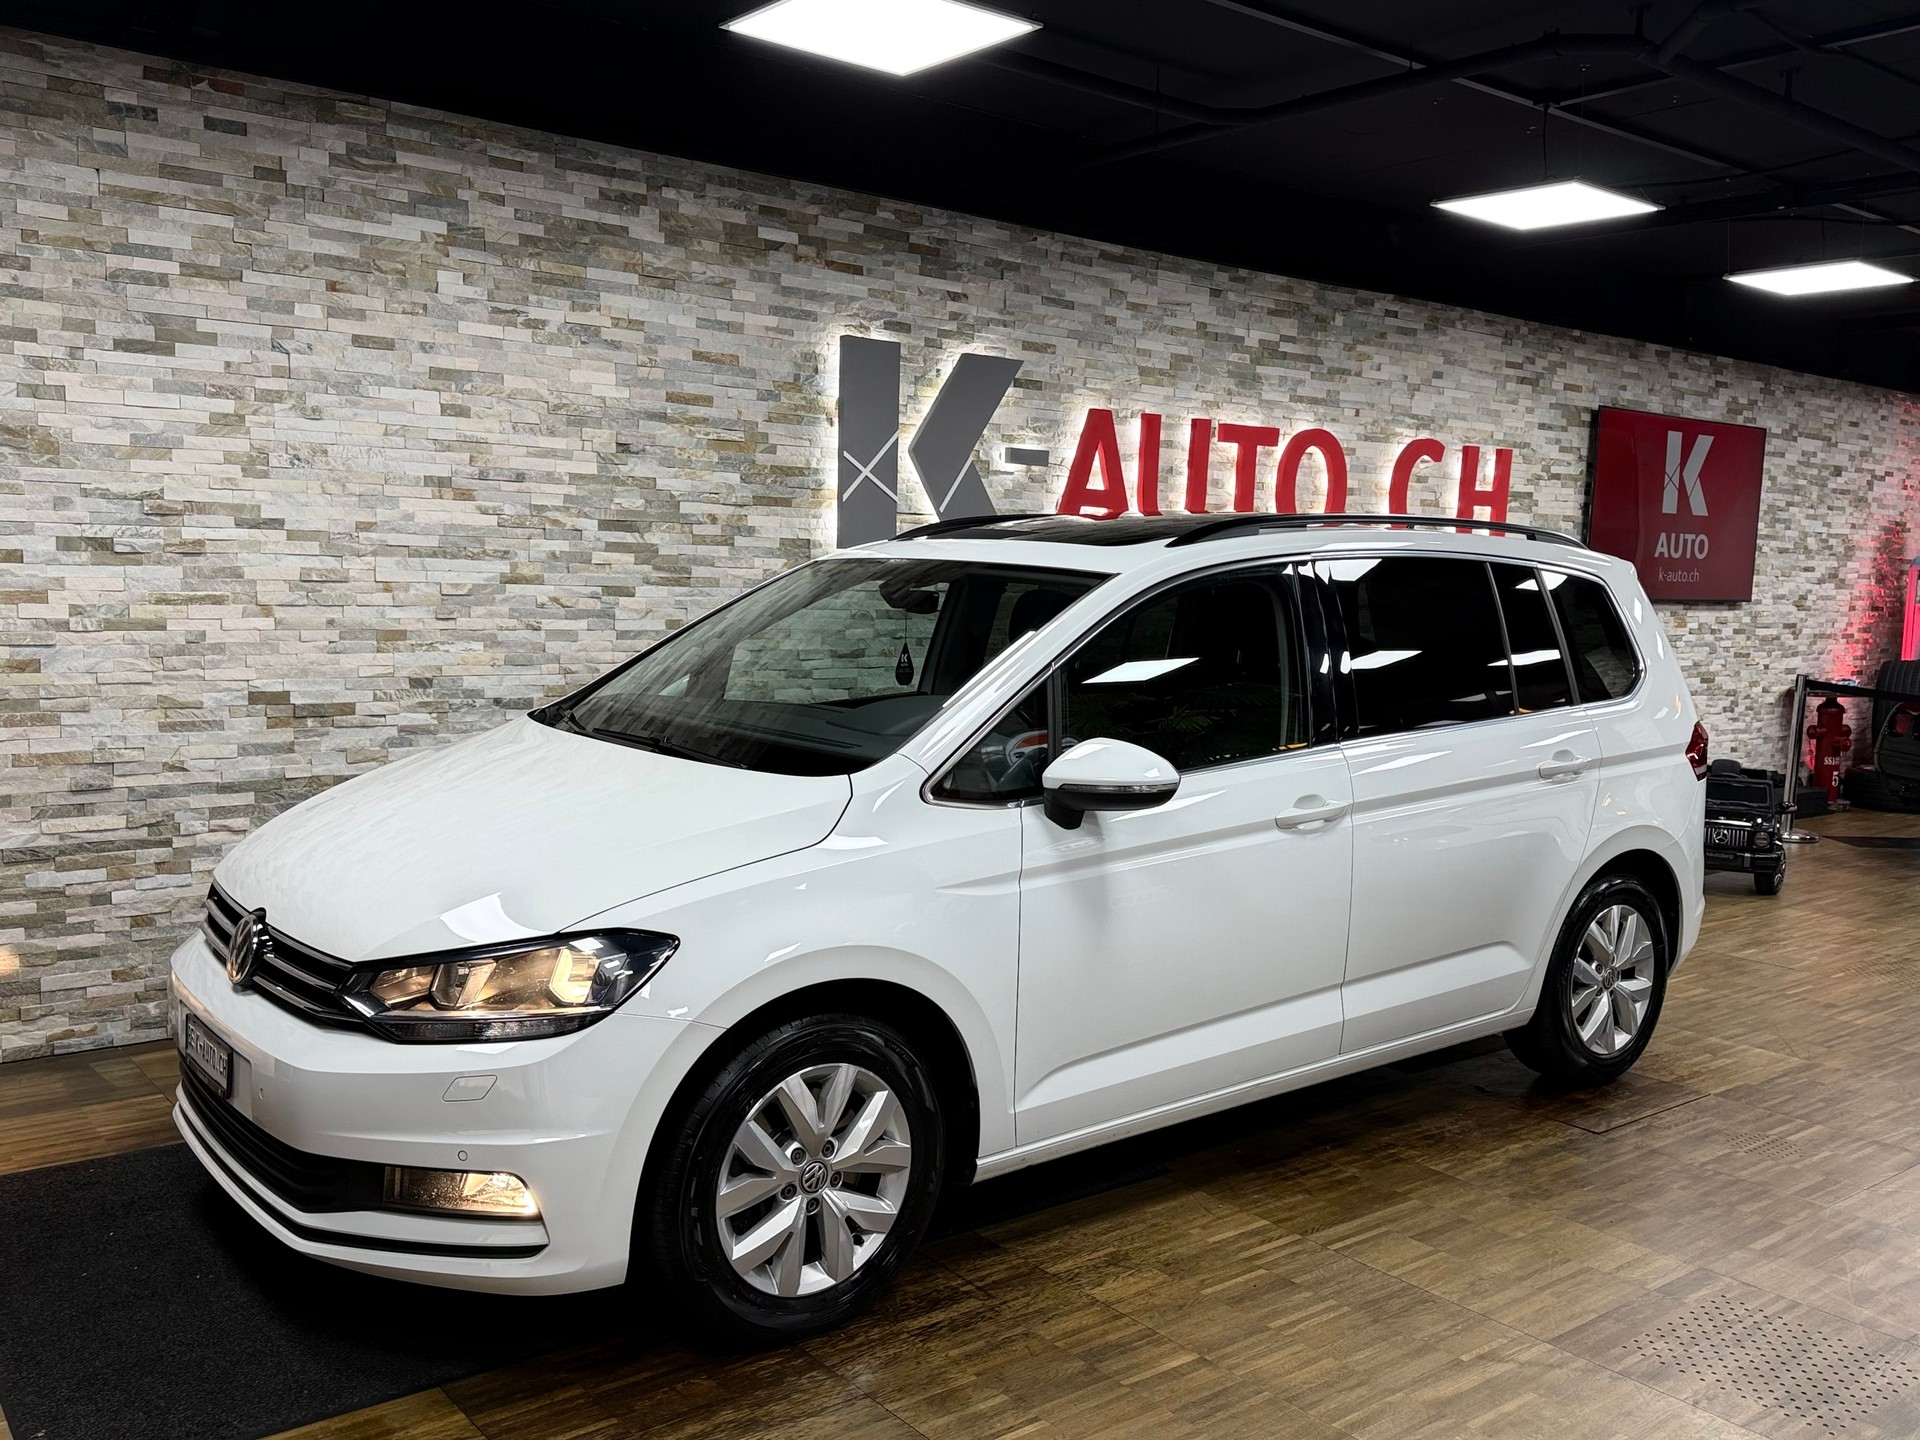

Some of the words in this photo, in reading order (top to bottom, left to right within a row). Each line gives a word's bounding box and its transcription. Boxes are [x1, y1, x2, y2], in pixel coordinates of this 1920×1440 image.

[837, 334, 1514, 549] K-AUTOCH
[1661, 430, 1715, 517] K
[1654, 532, 1709, 560] AUTO
[1658, 567, 1700, 583] k-auto.ch
[1831, 771, 1839, 787] 5
